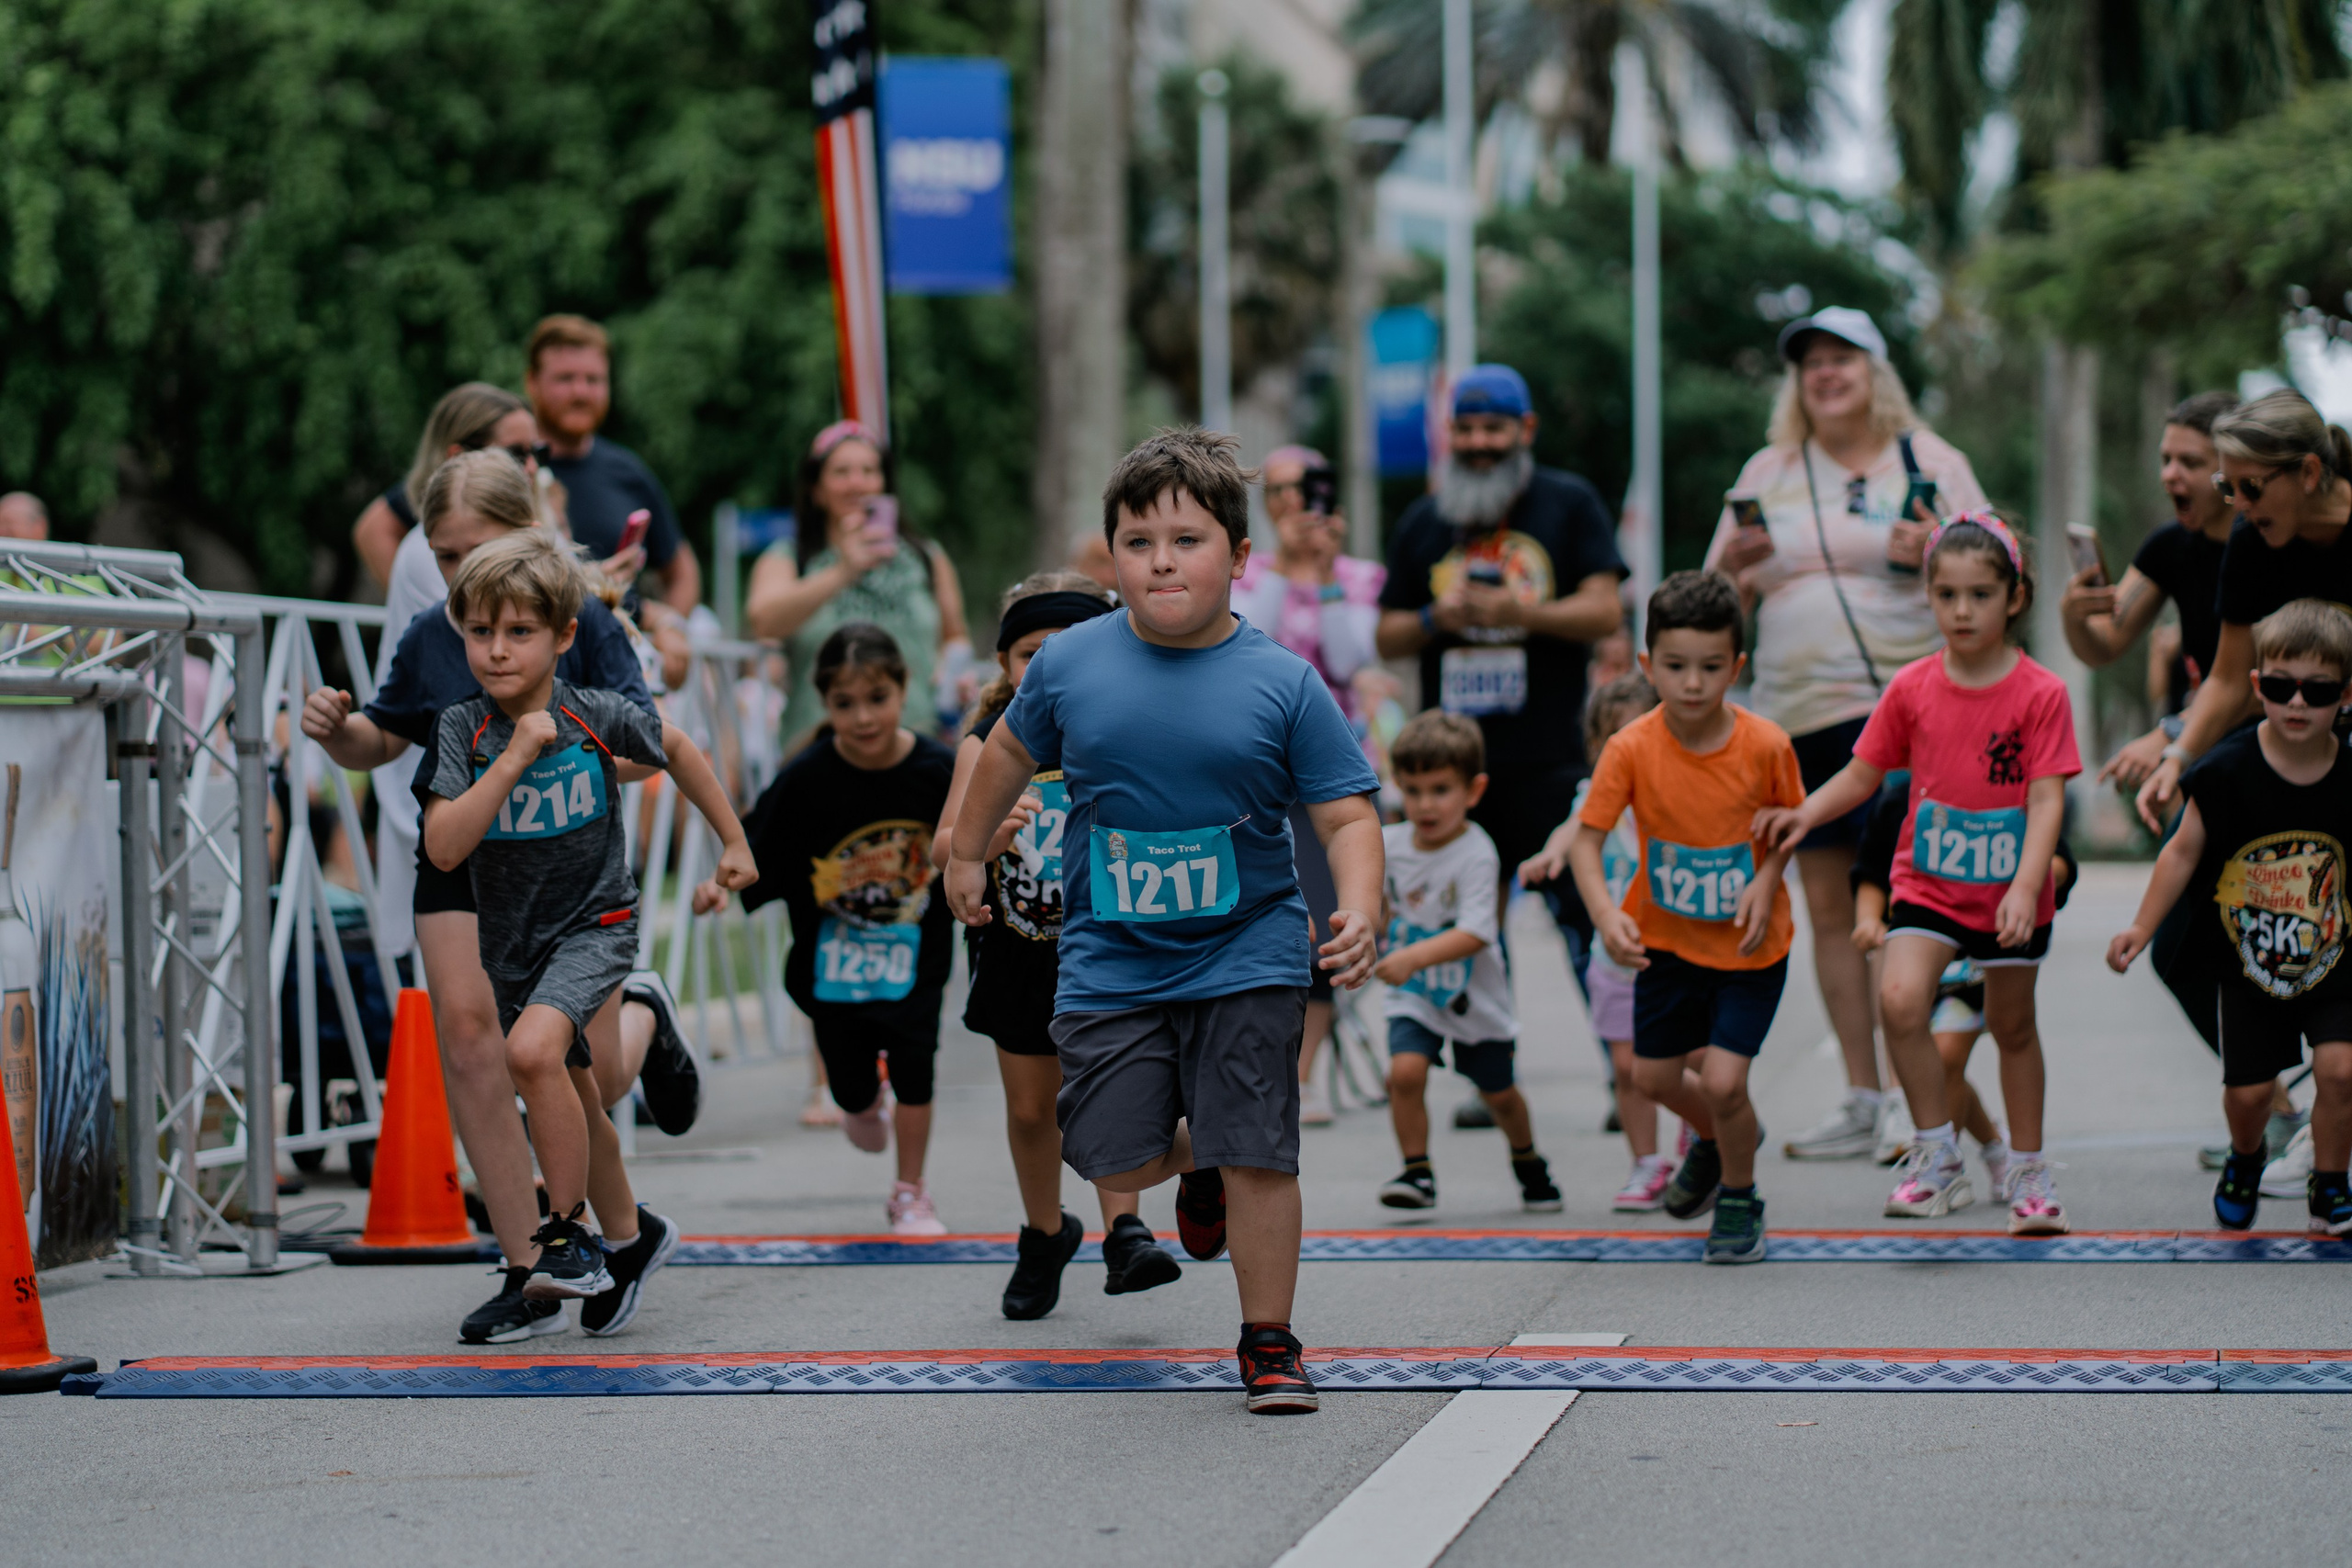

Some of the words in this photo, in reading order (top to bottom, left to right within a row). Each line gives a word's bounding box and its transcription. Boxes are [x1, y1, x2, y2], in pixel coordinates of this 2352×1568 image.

[531, 771, 556, 779] Taco
[557, 761, 576, 774] Trot
[498, 770, 596, 832] 1214
[1148, 846, 1175, 855] Taco
[1177, 843, 1201, 852] Trot
[1922, 828, 2017, 879] 1218
[1106, 855, 1218, 915] 1217
[1654, 864, 1746, 916] 1219
[2257, 910, 2301, 957] 5K
[820, 939, 913, 983] 1250
